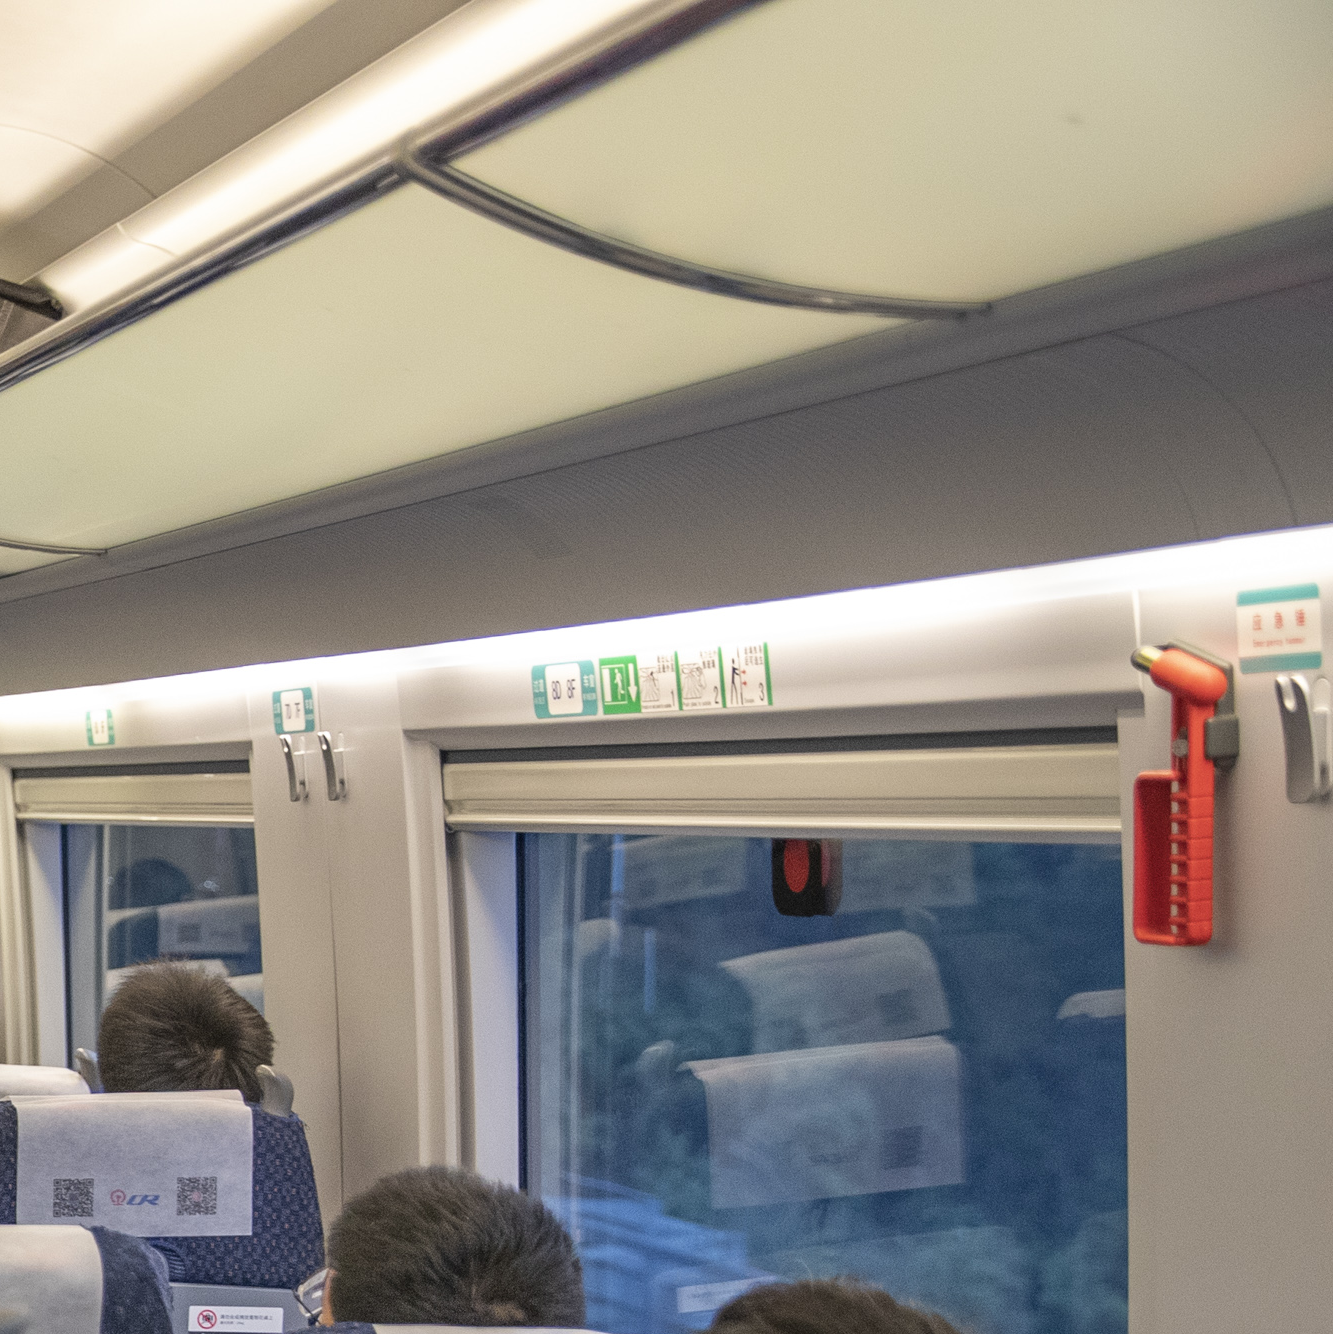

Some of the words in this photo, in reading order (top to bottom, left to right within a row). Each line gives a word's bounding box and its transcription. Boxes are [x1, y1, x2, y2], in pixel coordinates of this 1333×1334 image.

[551, 681, 562, 700] 8D
[567, 679, 576, 699] 8F
[670, 688, 675, 706] 1
[713, 685, 719, 704] 2
[759, 682, 765, 702] 3
[126, 1194, 160, 1206] CR
